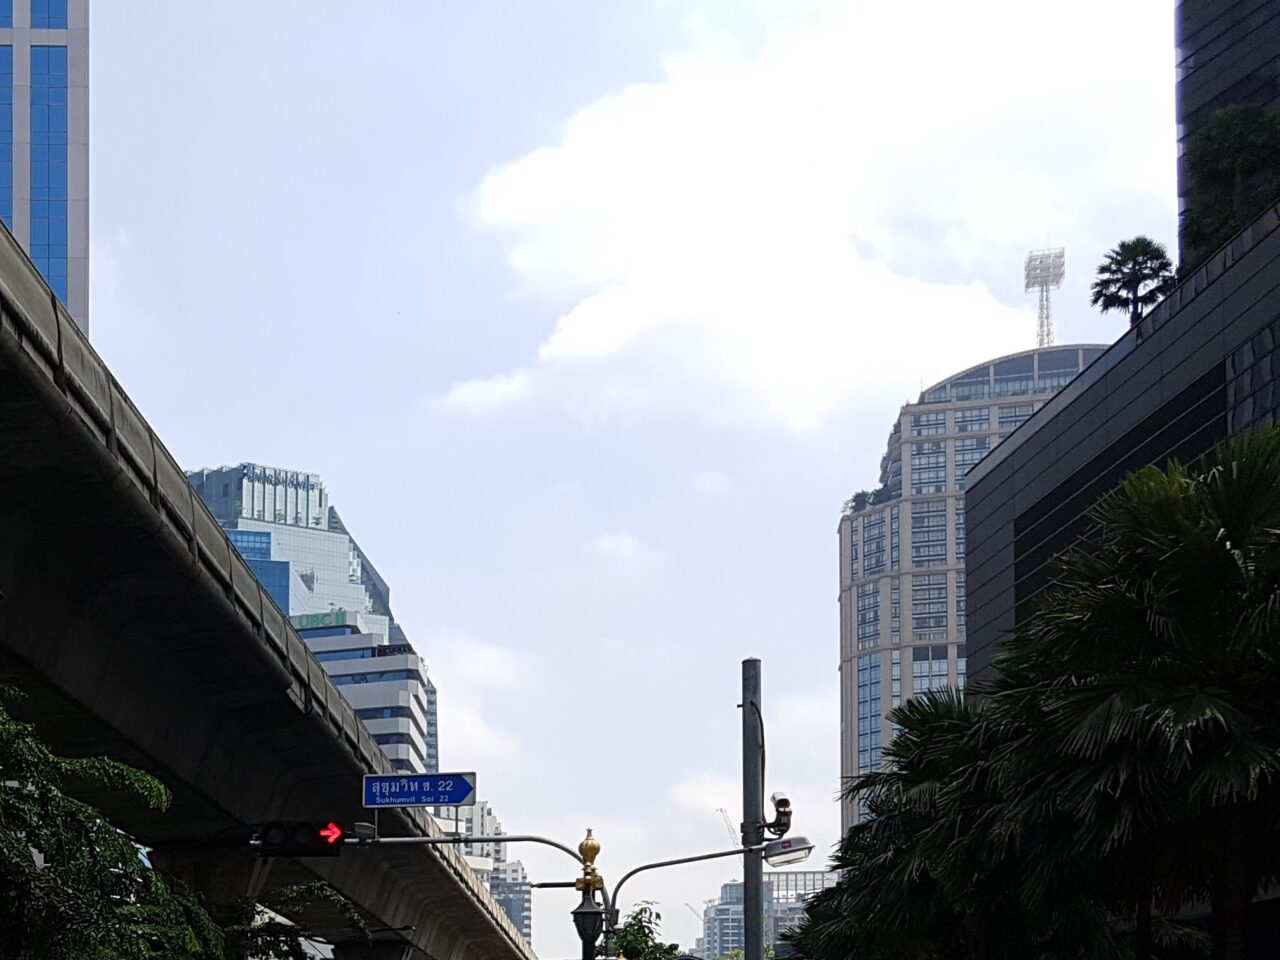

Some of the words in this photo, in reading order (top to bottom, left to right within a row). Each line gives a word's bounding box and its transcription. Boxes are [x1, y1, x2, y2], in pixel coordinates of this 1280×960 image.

[372, 778, 418, 796] สุขุมวิท
[423, 782, 434, 791] ซ.
[438, 780, 453, 791] 22
[376, 796, 415, 804] Sukhumvit
[421, 795, 434, 803] Soi
